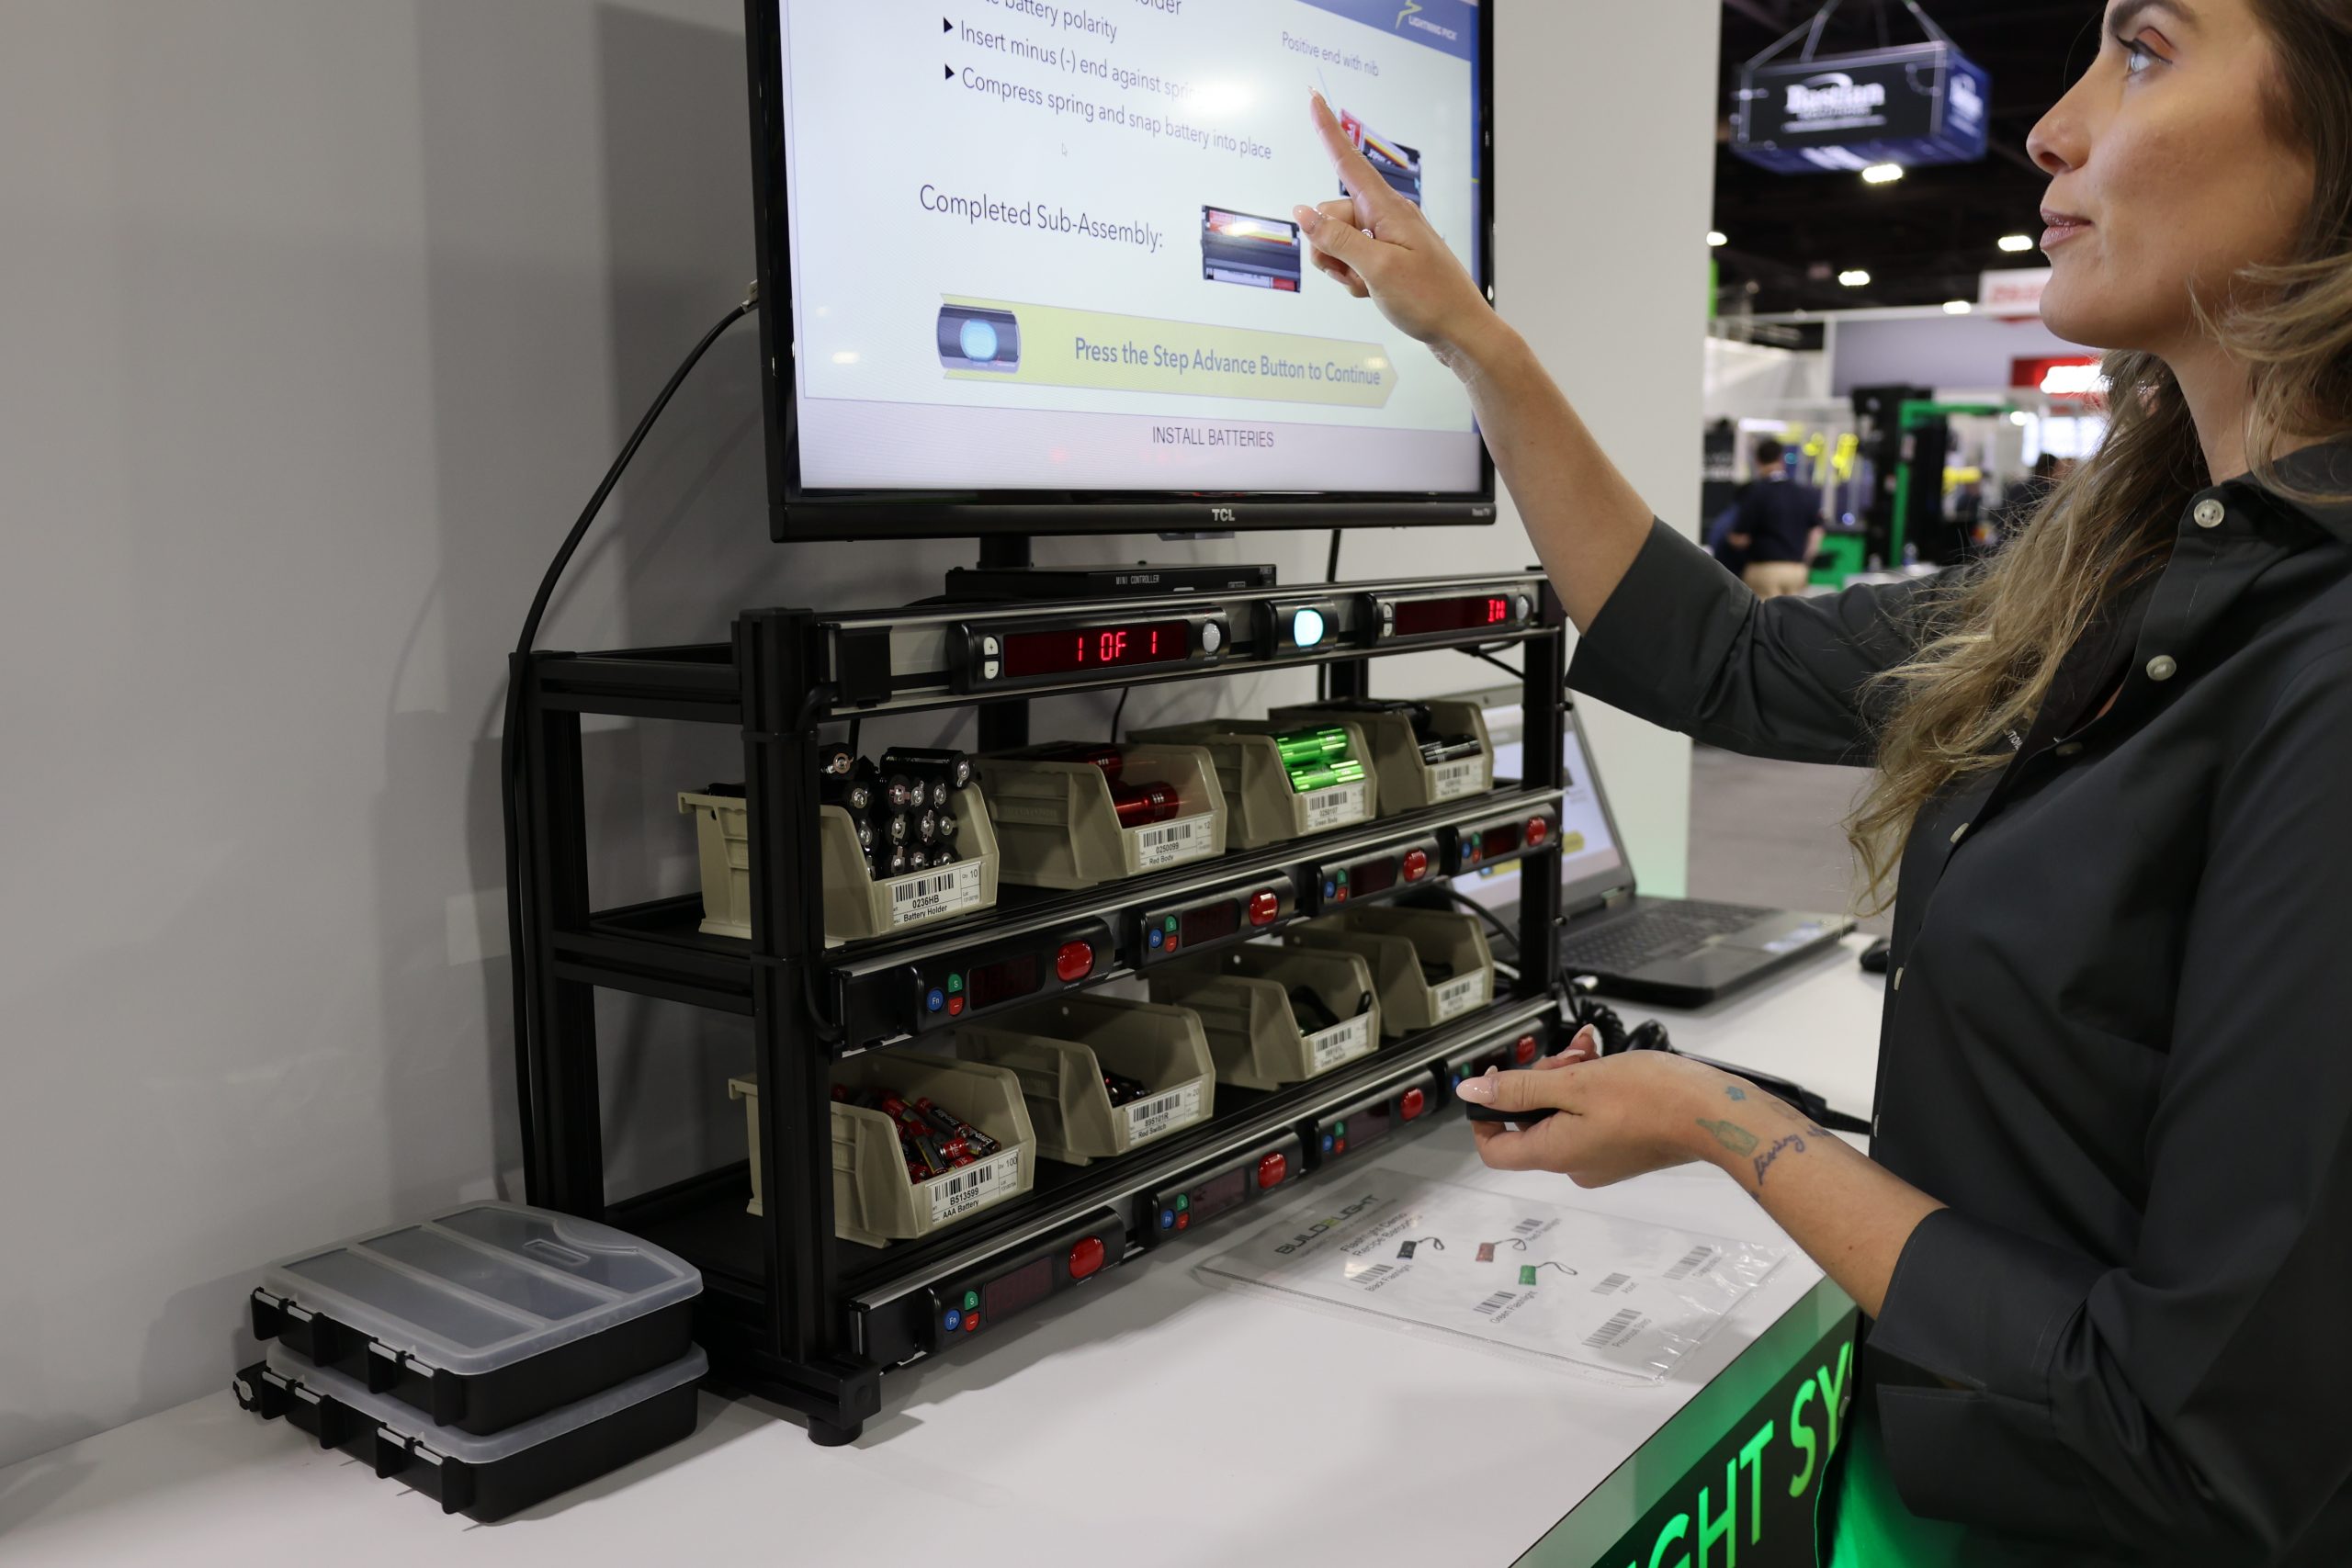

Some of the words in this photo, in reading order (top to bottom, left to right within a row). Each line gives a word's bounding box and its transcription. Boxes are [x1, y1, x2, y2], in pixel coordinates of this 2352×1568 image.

[1064, 9, 1117, 43] polarity
[961, 19, 1006, 51] Insert
[1012, 38, 1056, 65] minus
[1060, 47, 1076, 73] (-)
[1080, 59, 1107, 78] end
[1112, 69, 1160, 92] against
[1282, 31, 1319, 58] Positive
[1322, 50, 1340, 64] end
[1343, 54, 1363, 72] with
[1364, 60, 1379, 76] nib
[962, 67, 1043, 102] Compress
[1048, 94, 1094, 122] spring
[1099, 105, 1125, 124] and
[1129, 113, 1161, 138] snap
[1166, 116, 1209, 149] battery
[1214, 129, 1237, 152] into
[1240, 137, 1272, 160] place
[921, 185, 1031, 226] Completed
[1037, 205, 1163, 254] Sub-Assembly:
[1075, 337, 1117, 363] Press
[1122, 341, 1148, 365] the
[1154, 344, 1189, 375] Step
[1193, 348, 1256, 375] Advance
[1261, 355, 1305, 378] Button
[1308, 363, 1321, 379] to
[1325, 362, 1381, 385] Continue
[1153, 426, 1204, 446] INSTALL
[1208, 429, 1273, 447] BATTERIES
[1212, 508, 1235, 522] TCL
[1116, 576, 1128, 585] MINI
[1131, 574, 1159, 584] CONTROLLER
[1078, 637, 1082, 661] 1
[1101, 632, 1126, 660] OF
[1151, 630, 1157, 654] 1
[1160, 854, 1174, 863] Body
[970, 869, 978, 878] 10
[912, 895, 939, 908] 0236HB
[904, 911, 926, 922] Battery
[928, 905, 947, 916] Holder
[1149, 1124, 1166, 1134] Switch
[950, 1188, 978, 1205] B513599
[943, 1210, 956, 1219] AAA
[957, 1200, 978, 1213] Battery
[1789, 1341, 1853, 1497] SY
